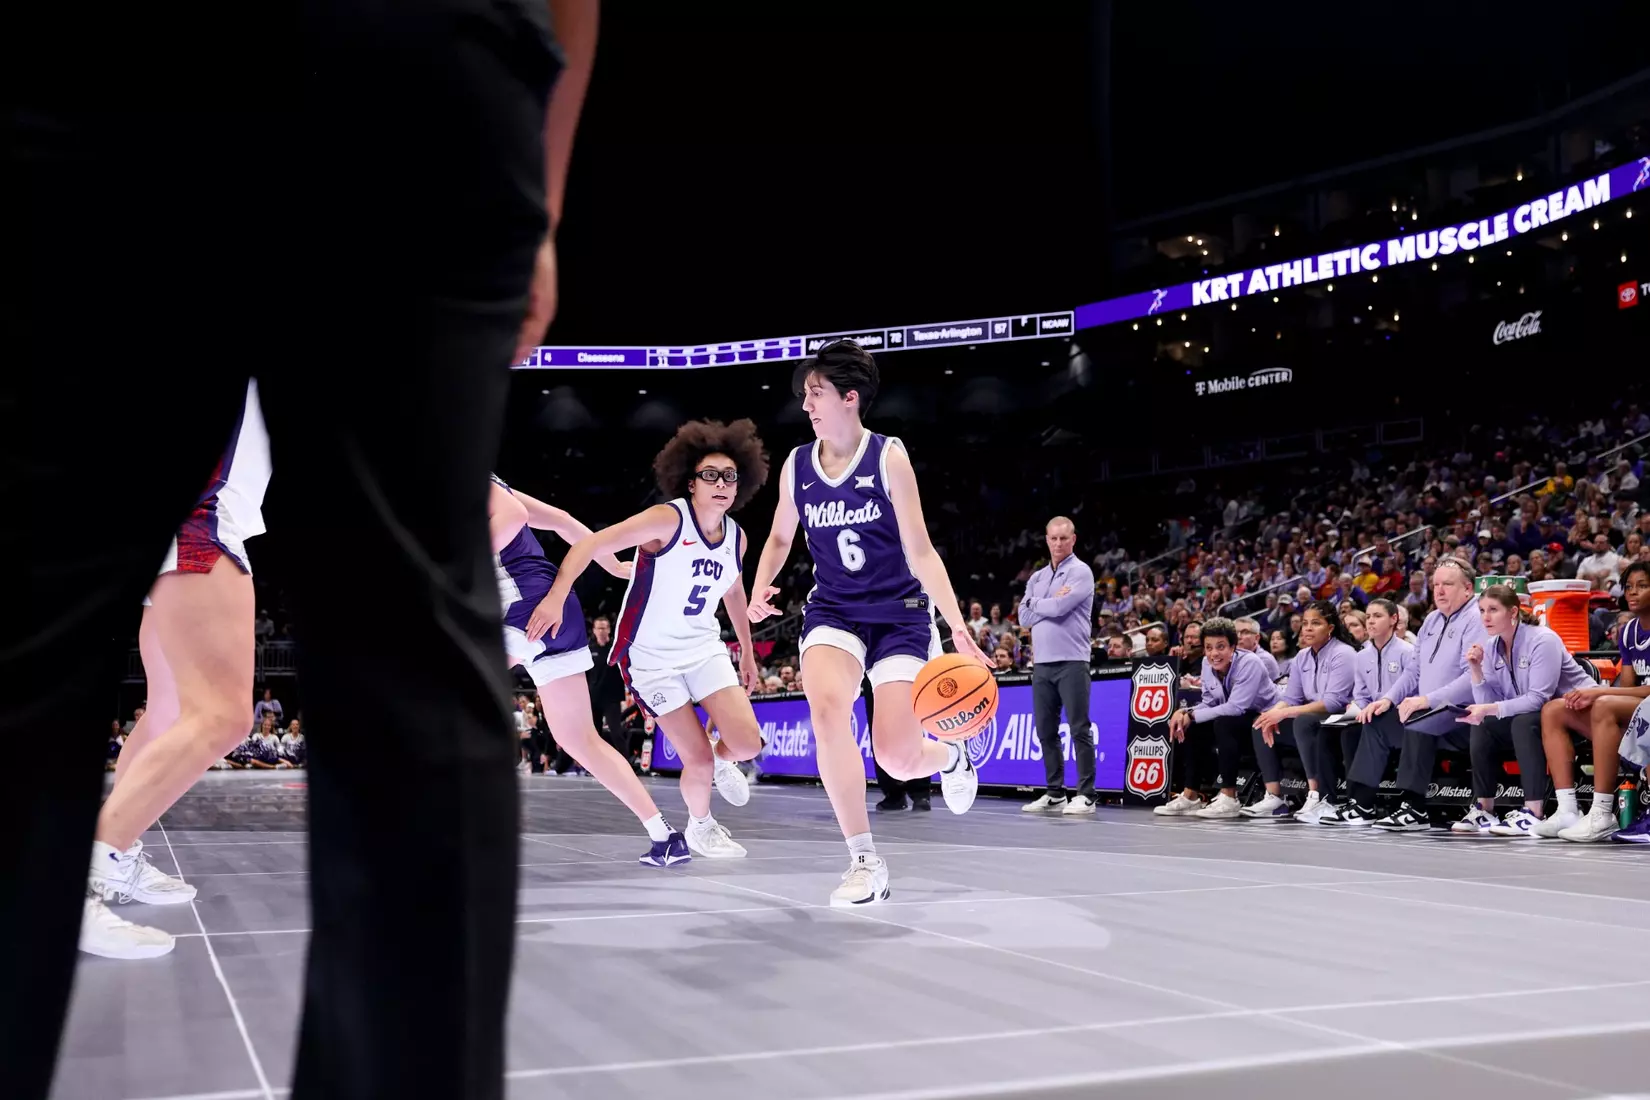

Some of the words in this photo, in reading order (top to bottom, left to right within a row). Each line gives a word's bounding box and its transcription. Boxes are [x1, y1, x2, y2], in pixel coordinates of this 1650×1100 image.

[1192, 273, 1244, 306] KRT
[1247, 243, 1381, 295] ATHLETIC
[1387, 212, 1509, 266] MUSCLE
[1513, 173, 1611, 234] CREAM
[1207, 376, 1246, 394] Mobile
[1247, 371, 1289, 388] CENTER
[804, 498, 883, 528] Wildcats
[836, 528, 867, 572] 6
[691, 558, 724, 581] TCU
[683, 584, 711, 616] 5
[1138, 672, 1170, 684] PHILLIPS
[1138, 689, 1166, 713] 66
[936, 696, 991, 732] Wilson
[1133, 745, 1164, 757] PHILLIPS
[1133, 761, 1161, 785] 66
[1436, 785, 1473, 798] Allstate
